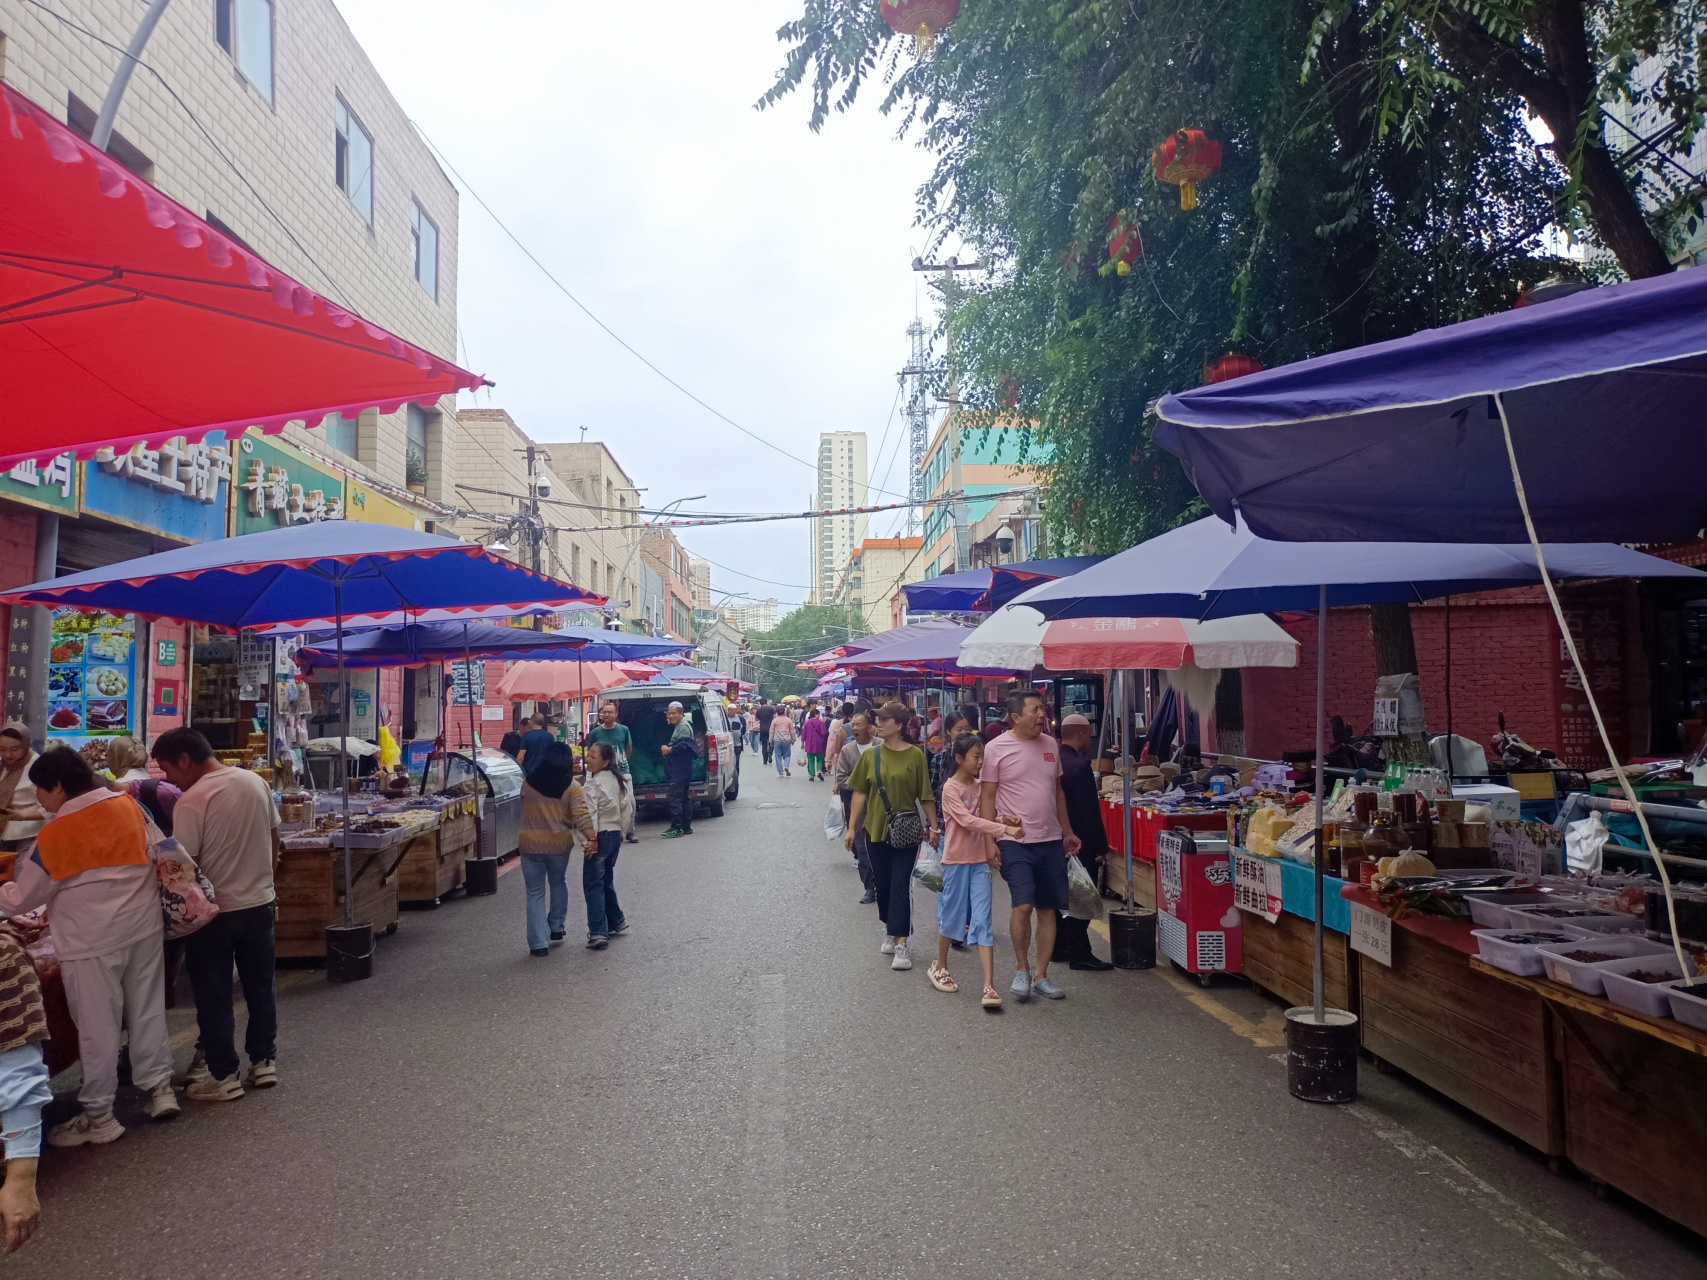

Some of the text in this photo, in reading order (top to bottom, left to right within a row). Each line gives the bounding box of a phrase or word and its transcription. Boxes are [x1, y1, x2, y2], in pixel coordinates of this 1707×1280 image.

[158, 642, 166, 660] B
[242, 653, 271, 662] 天然蜂蜜
[1560, 637, 1622, 661] 眼镜
[1560, 666, 1621, 691] 专卖
[1565, 746, 1583, 754] 电话
[1235, 856, 1265, 885] 新鲜酥油
[1354, 907, 1388, 936] 门源奶皮
[1353, 929, 1389, 955] 一张28元
